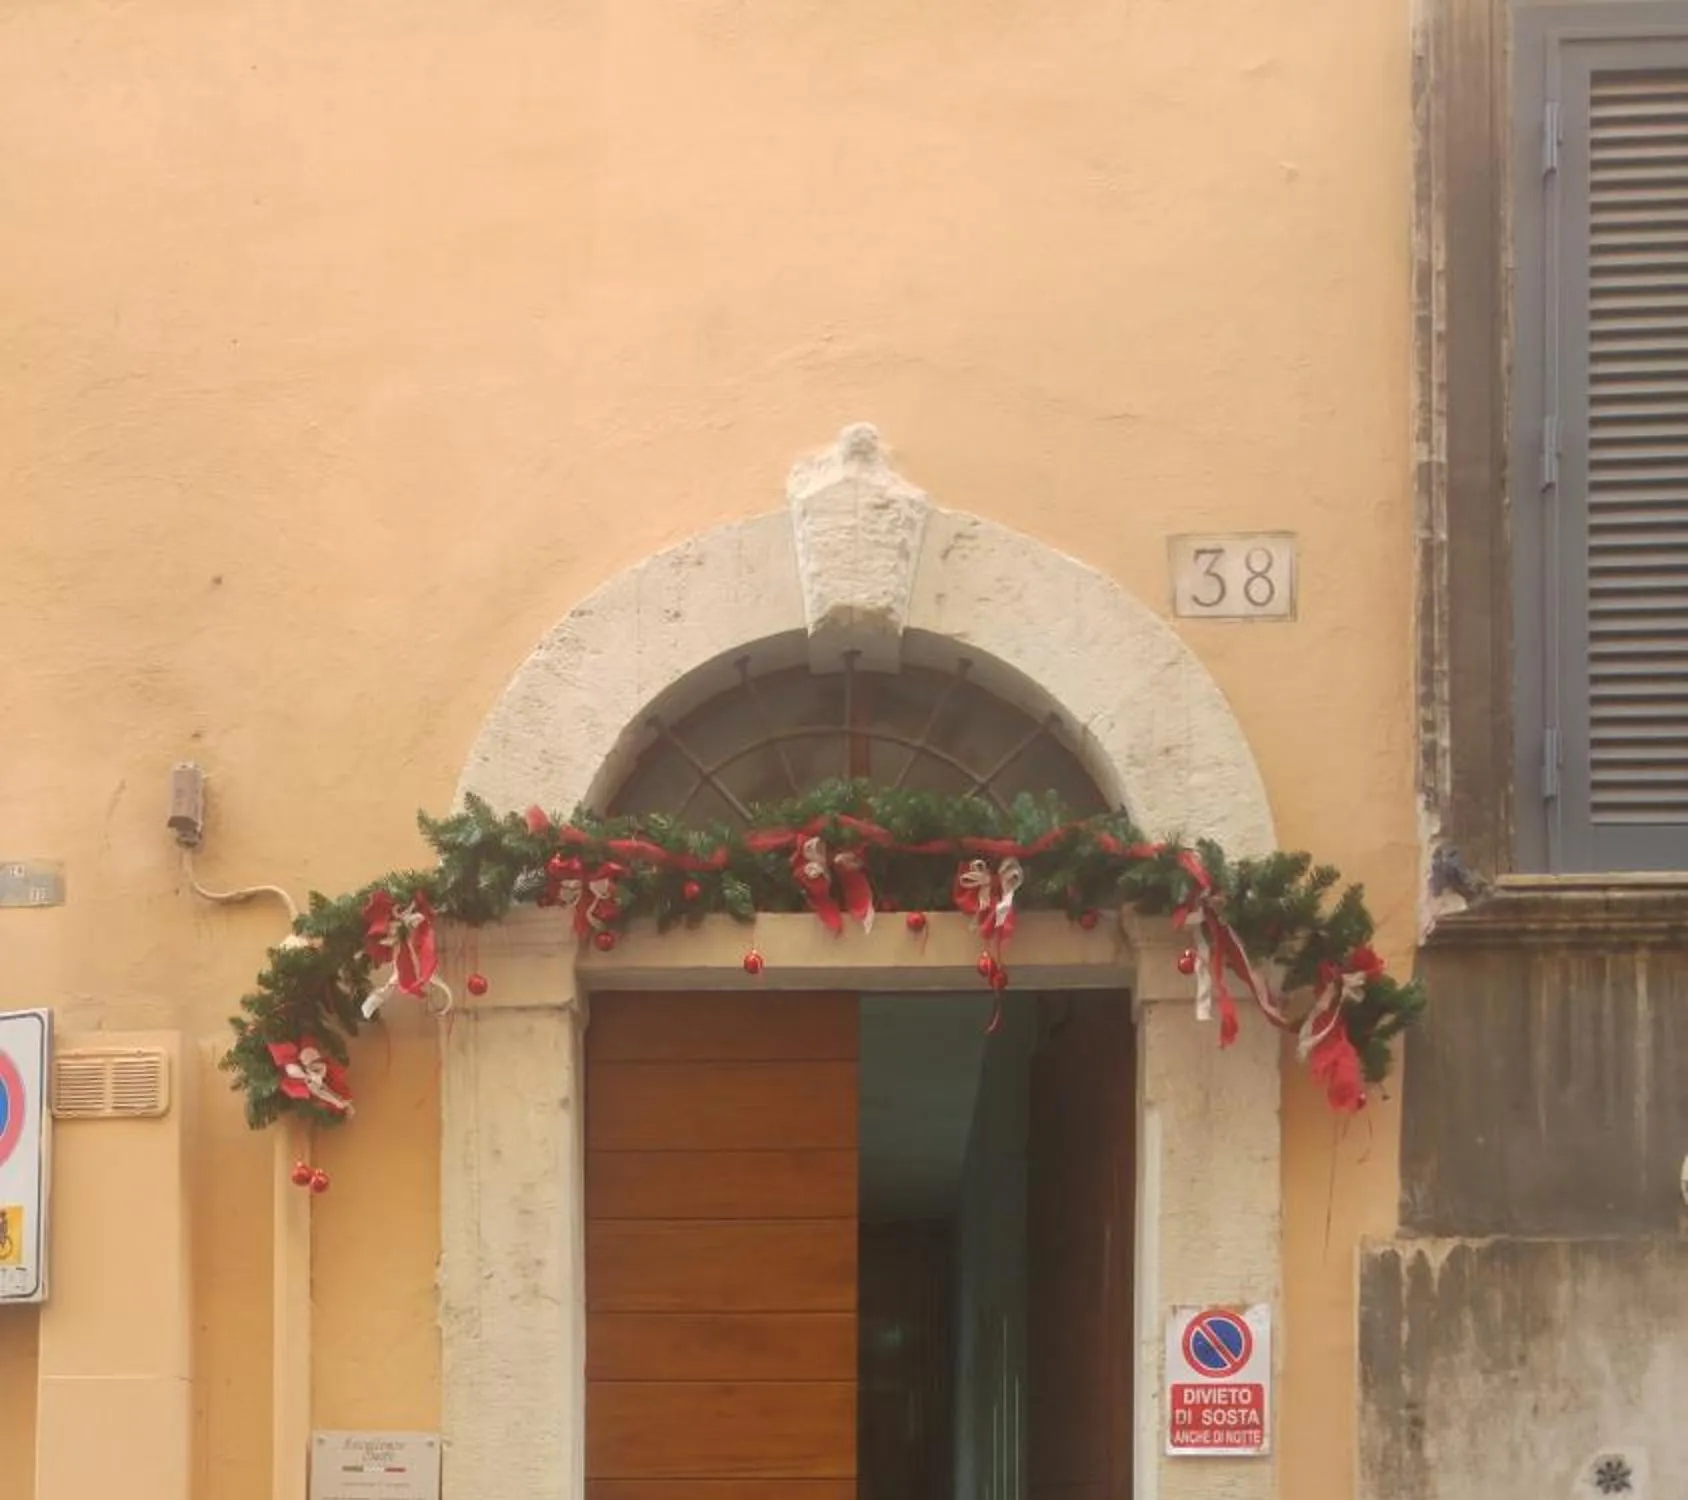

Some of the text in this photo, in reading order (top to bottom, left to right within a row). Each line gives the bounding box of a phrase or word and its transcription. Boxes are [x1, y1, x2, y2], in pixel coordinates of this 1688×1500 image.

[1191, 547, 1275, 607] 38
[1183, 1388, 1252, 1405] DIVIETO
[1175, 1408, 1260, 1425] DI SOSTA
[1174, 1430, 1261, 1444] ANCHE DI NOTTE
